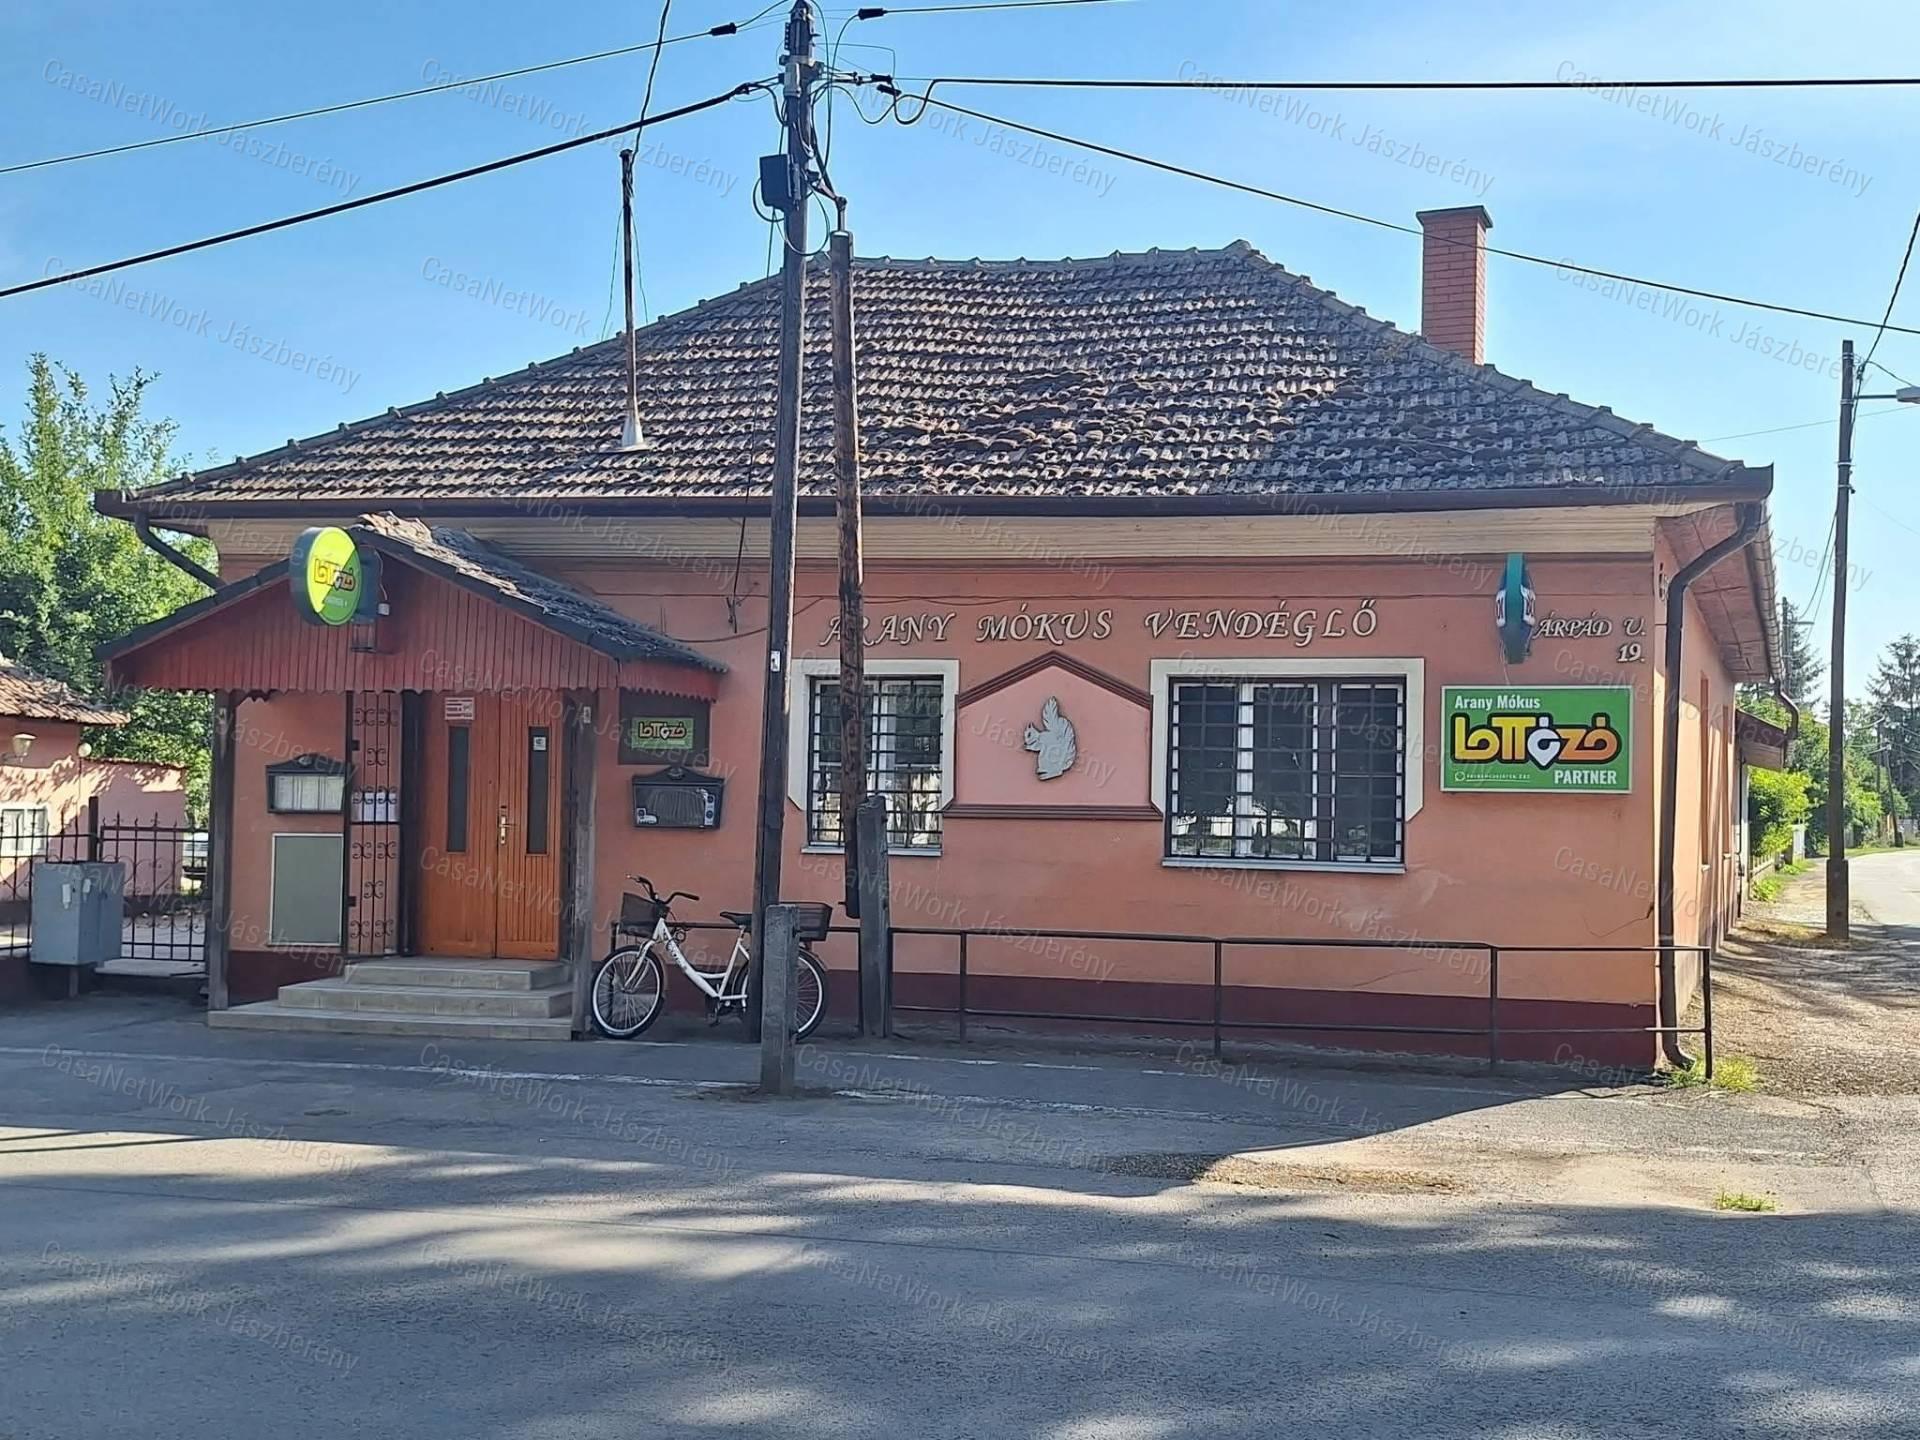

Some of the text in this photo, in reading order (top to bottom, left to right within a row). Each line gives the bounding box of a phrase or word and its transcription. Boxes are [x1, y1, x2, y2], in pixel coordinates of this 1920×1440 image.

[976, 603, 1112, 646] MÓKUS
[1144, 598, 1378, 648] VENDÉGLŐ
[1532, 610, 1646, 639] ÁRPÁD U.
[1617, 642, 1646, 663] 19.
[1454, 694, 1541, 711] Arany Mókus
[1554, 769, 1617, 785] PARTNER
